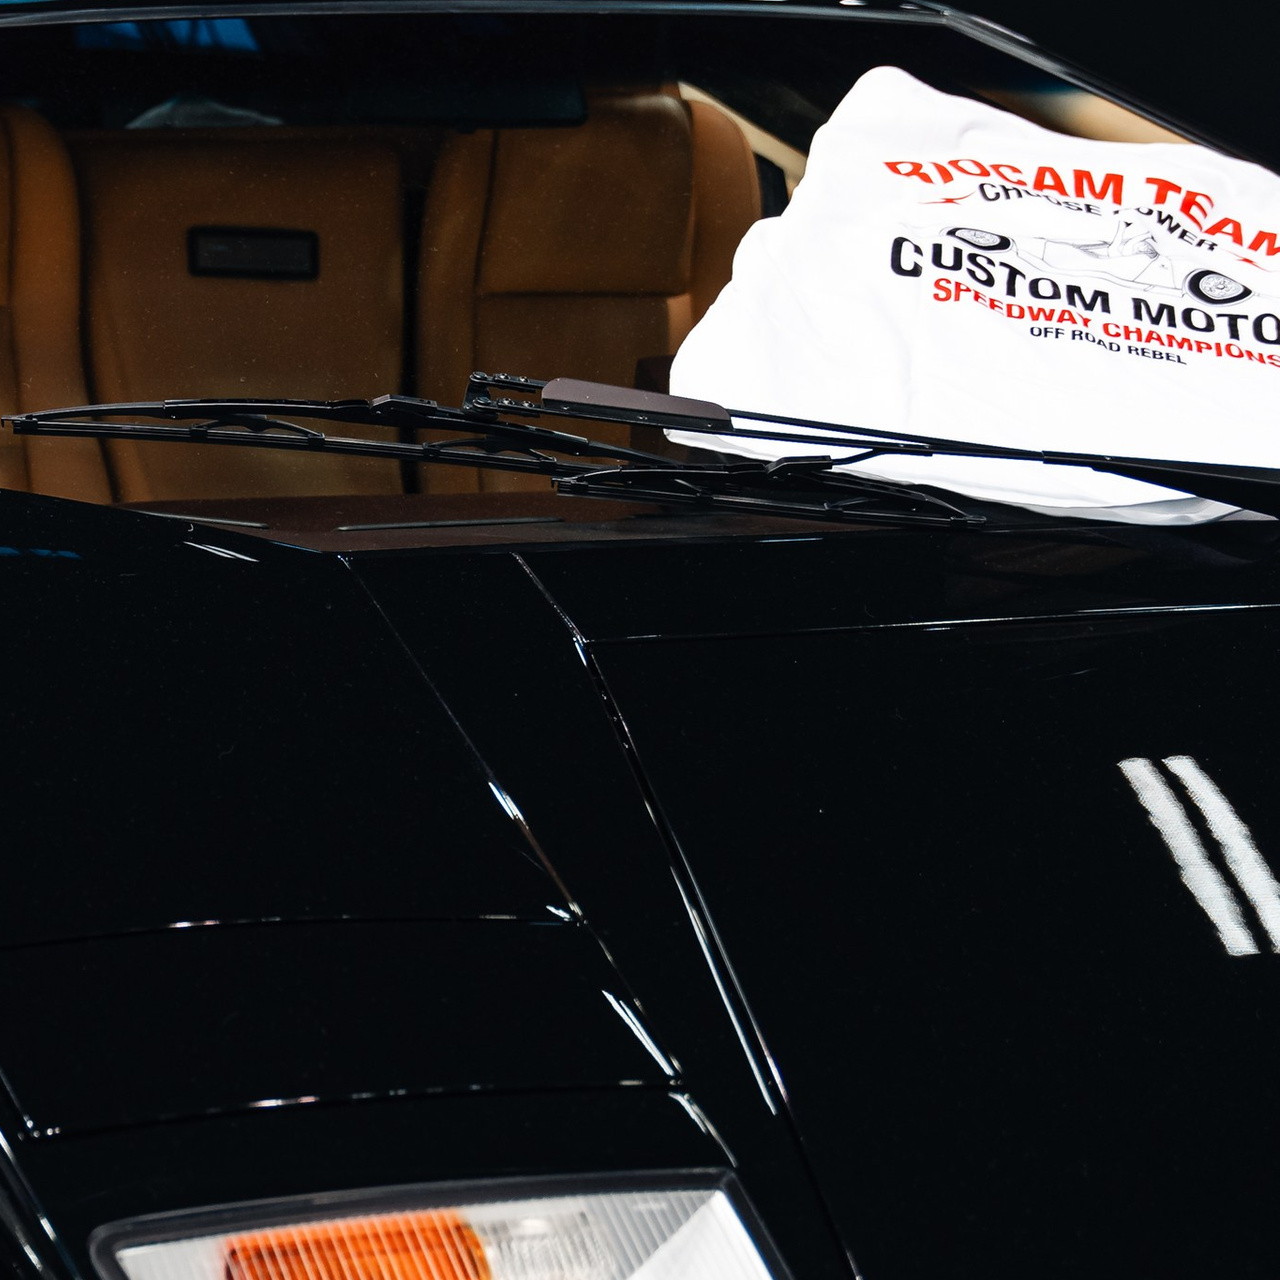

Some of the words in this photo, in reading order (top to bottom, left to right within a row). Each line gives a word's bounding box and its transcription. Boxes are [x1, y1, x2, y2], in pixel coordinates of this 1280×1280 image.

[883, 158, 1124, 206] RIOCAM
[890, 235, 1111, 314] CUSTOM
[932, 277, 1093, 328] SPEEDWAY
[1029, 326, 1065, 339] OFF
[1071, 329, 1121, 353] ROAD
[1127, 345, 1187, 365] REBEL
